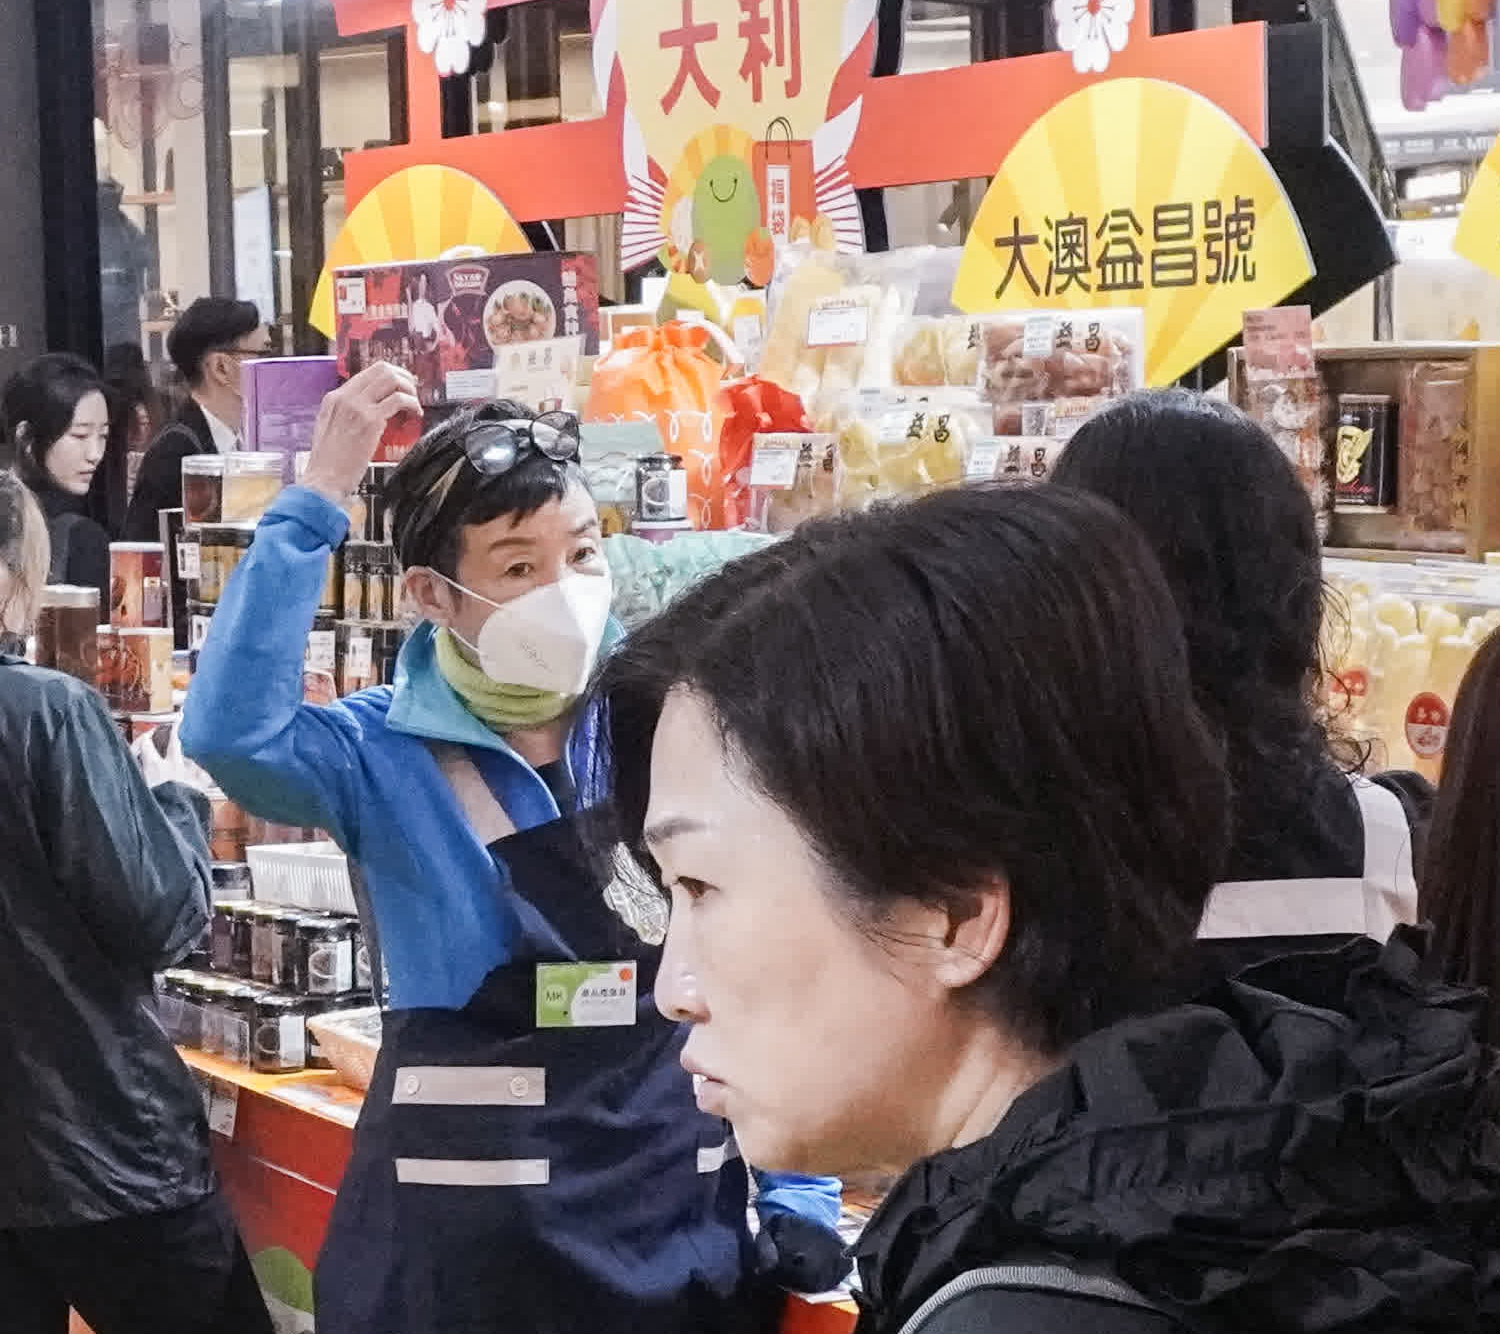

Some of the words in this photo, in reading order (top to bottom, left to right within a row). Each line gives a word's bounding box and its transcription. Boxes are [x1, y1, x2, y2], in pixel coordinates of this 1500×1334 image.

[993, 194, 1259, 299] 大澳益昌號
